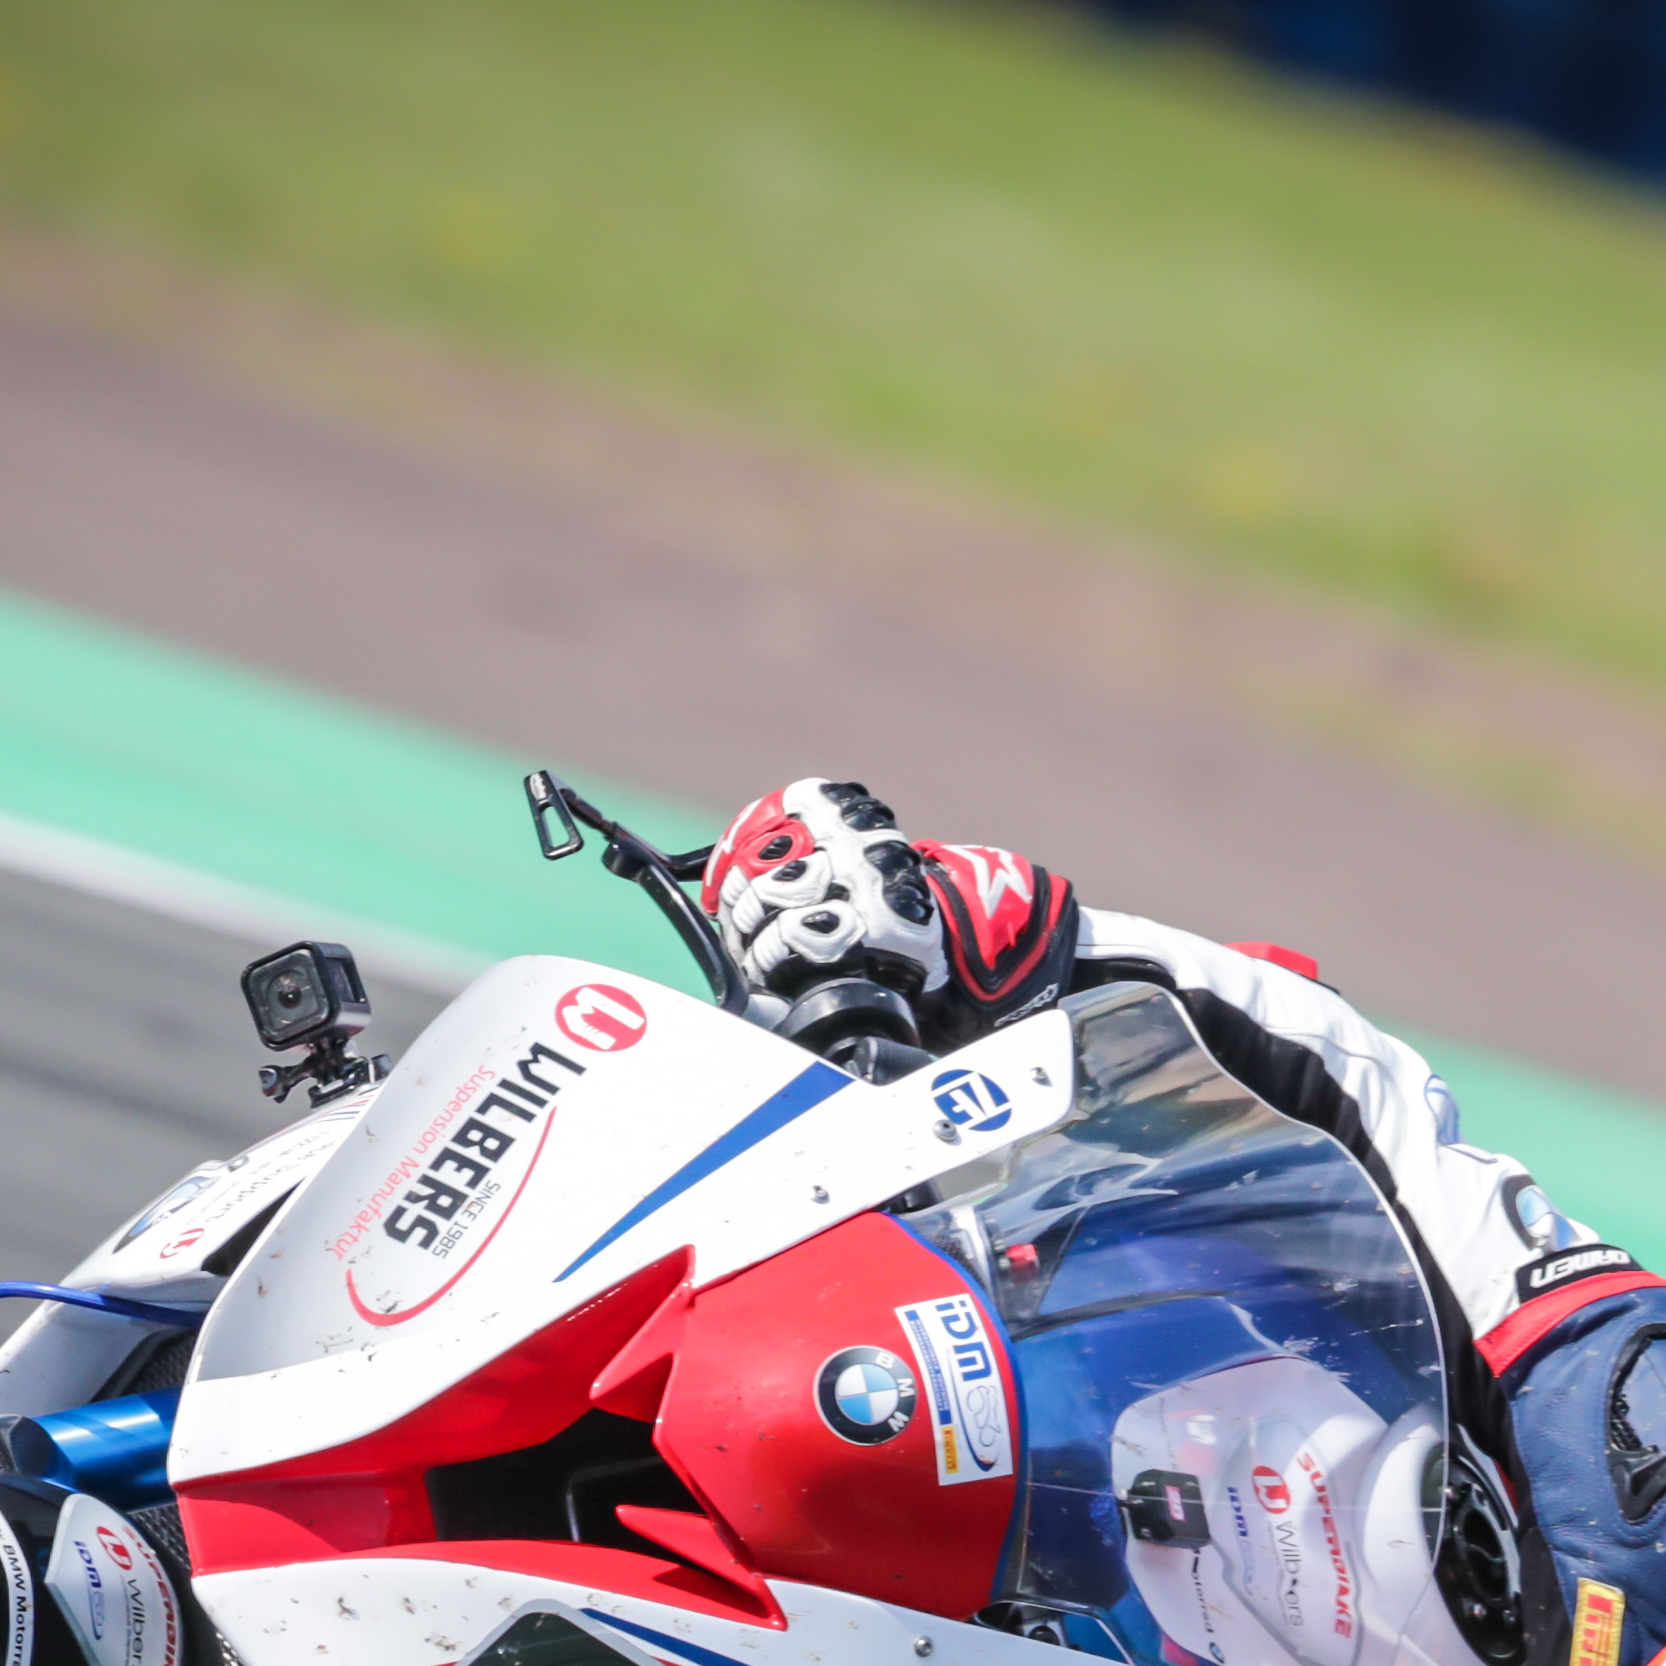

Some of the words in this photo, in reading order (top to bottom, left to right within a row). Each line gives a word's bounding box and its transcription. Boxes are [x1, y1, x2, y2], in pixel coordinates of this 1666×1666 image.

[411, 1064, 497, 1155] Suspension
[934, 1071, 1010, 1130] ZF
[383, 1042, 587, 1250] WILBERS
[335, 1155, 421, 1261] Manufaktur
[461, 1180, 502, 1222] SINCE
[432, 1220, 470, 1260] 1985
[875, 1351, 916, 1433] BMW
[3, 1545, 26, 1592] BMW
